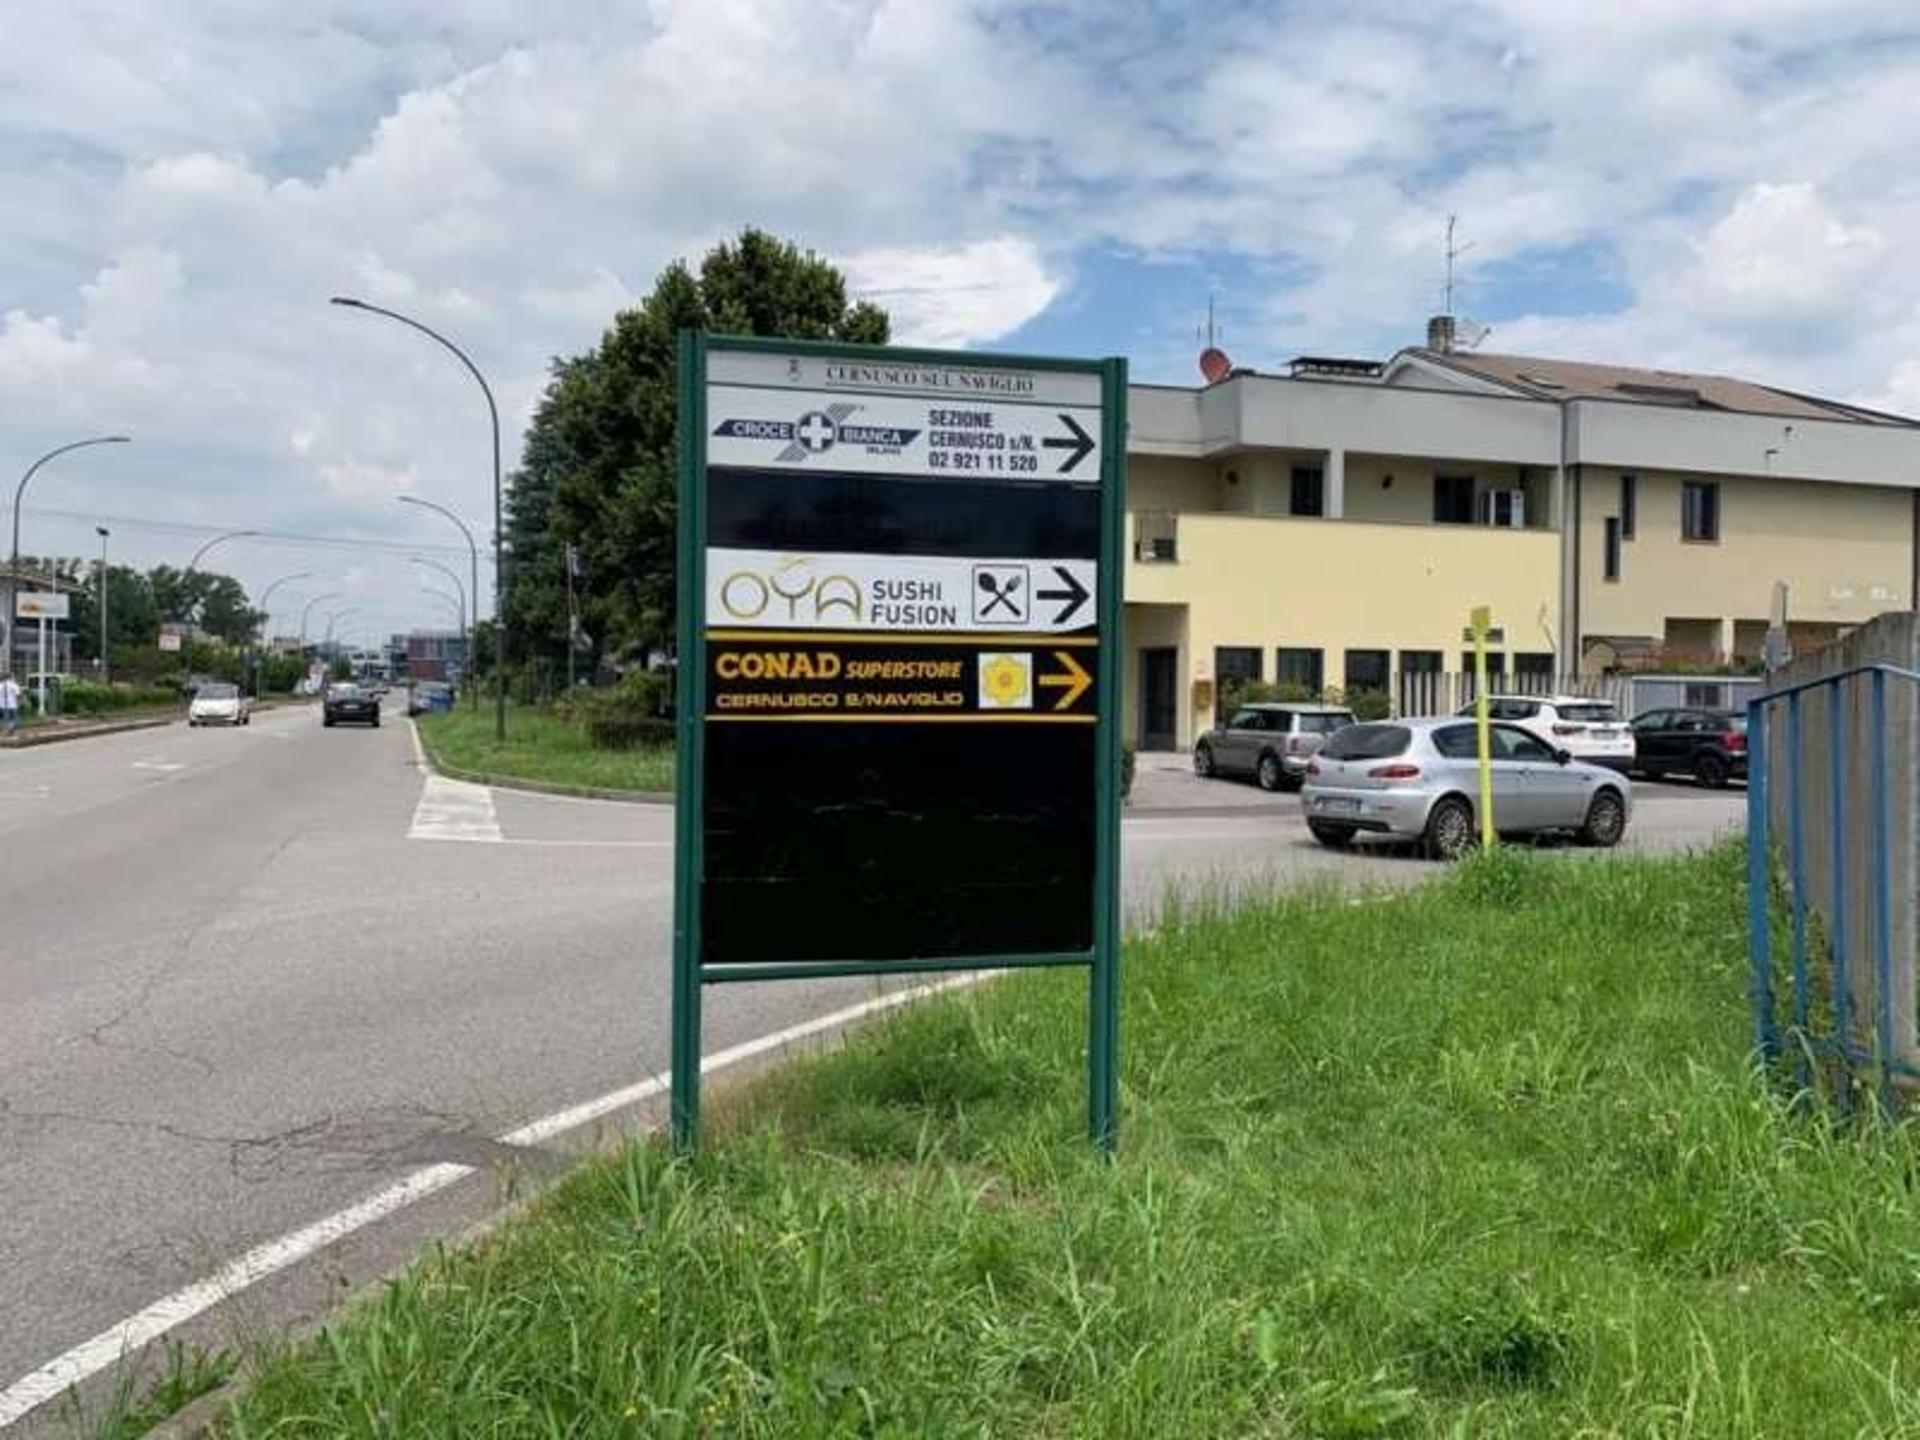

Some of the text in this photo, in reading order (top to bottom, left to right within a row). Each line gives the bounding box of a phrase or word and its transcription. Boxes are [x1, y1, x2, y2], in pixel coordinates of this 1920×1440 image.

[929, 410, 993, 428] SEZIONE
[732, 421, 901, 444] CROCE BIANCA
[929, 430, 1005, 449] CERNUSCO
[928, 451, 948, 468] 02
[953, 452, 980, 469] 921
[988, 454, 1004, 470] 11
[872, 580, 942, 600] SUSHI
[871, 604, 956, 625] FUSION
[715, 652, 962, 679] CONAD SUPERSTORE
[715, 692, 839, 709] CERNUSCO
